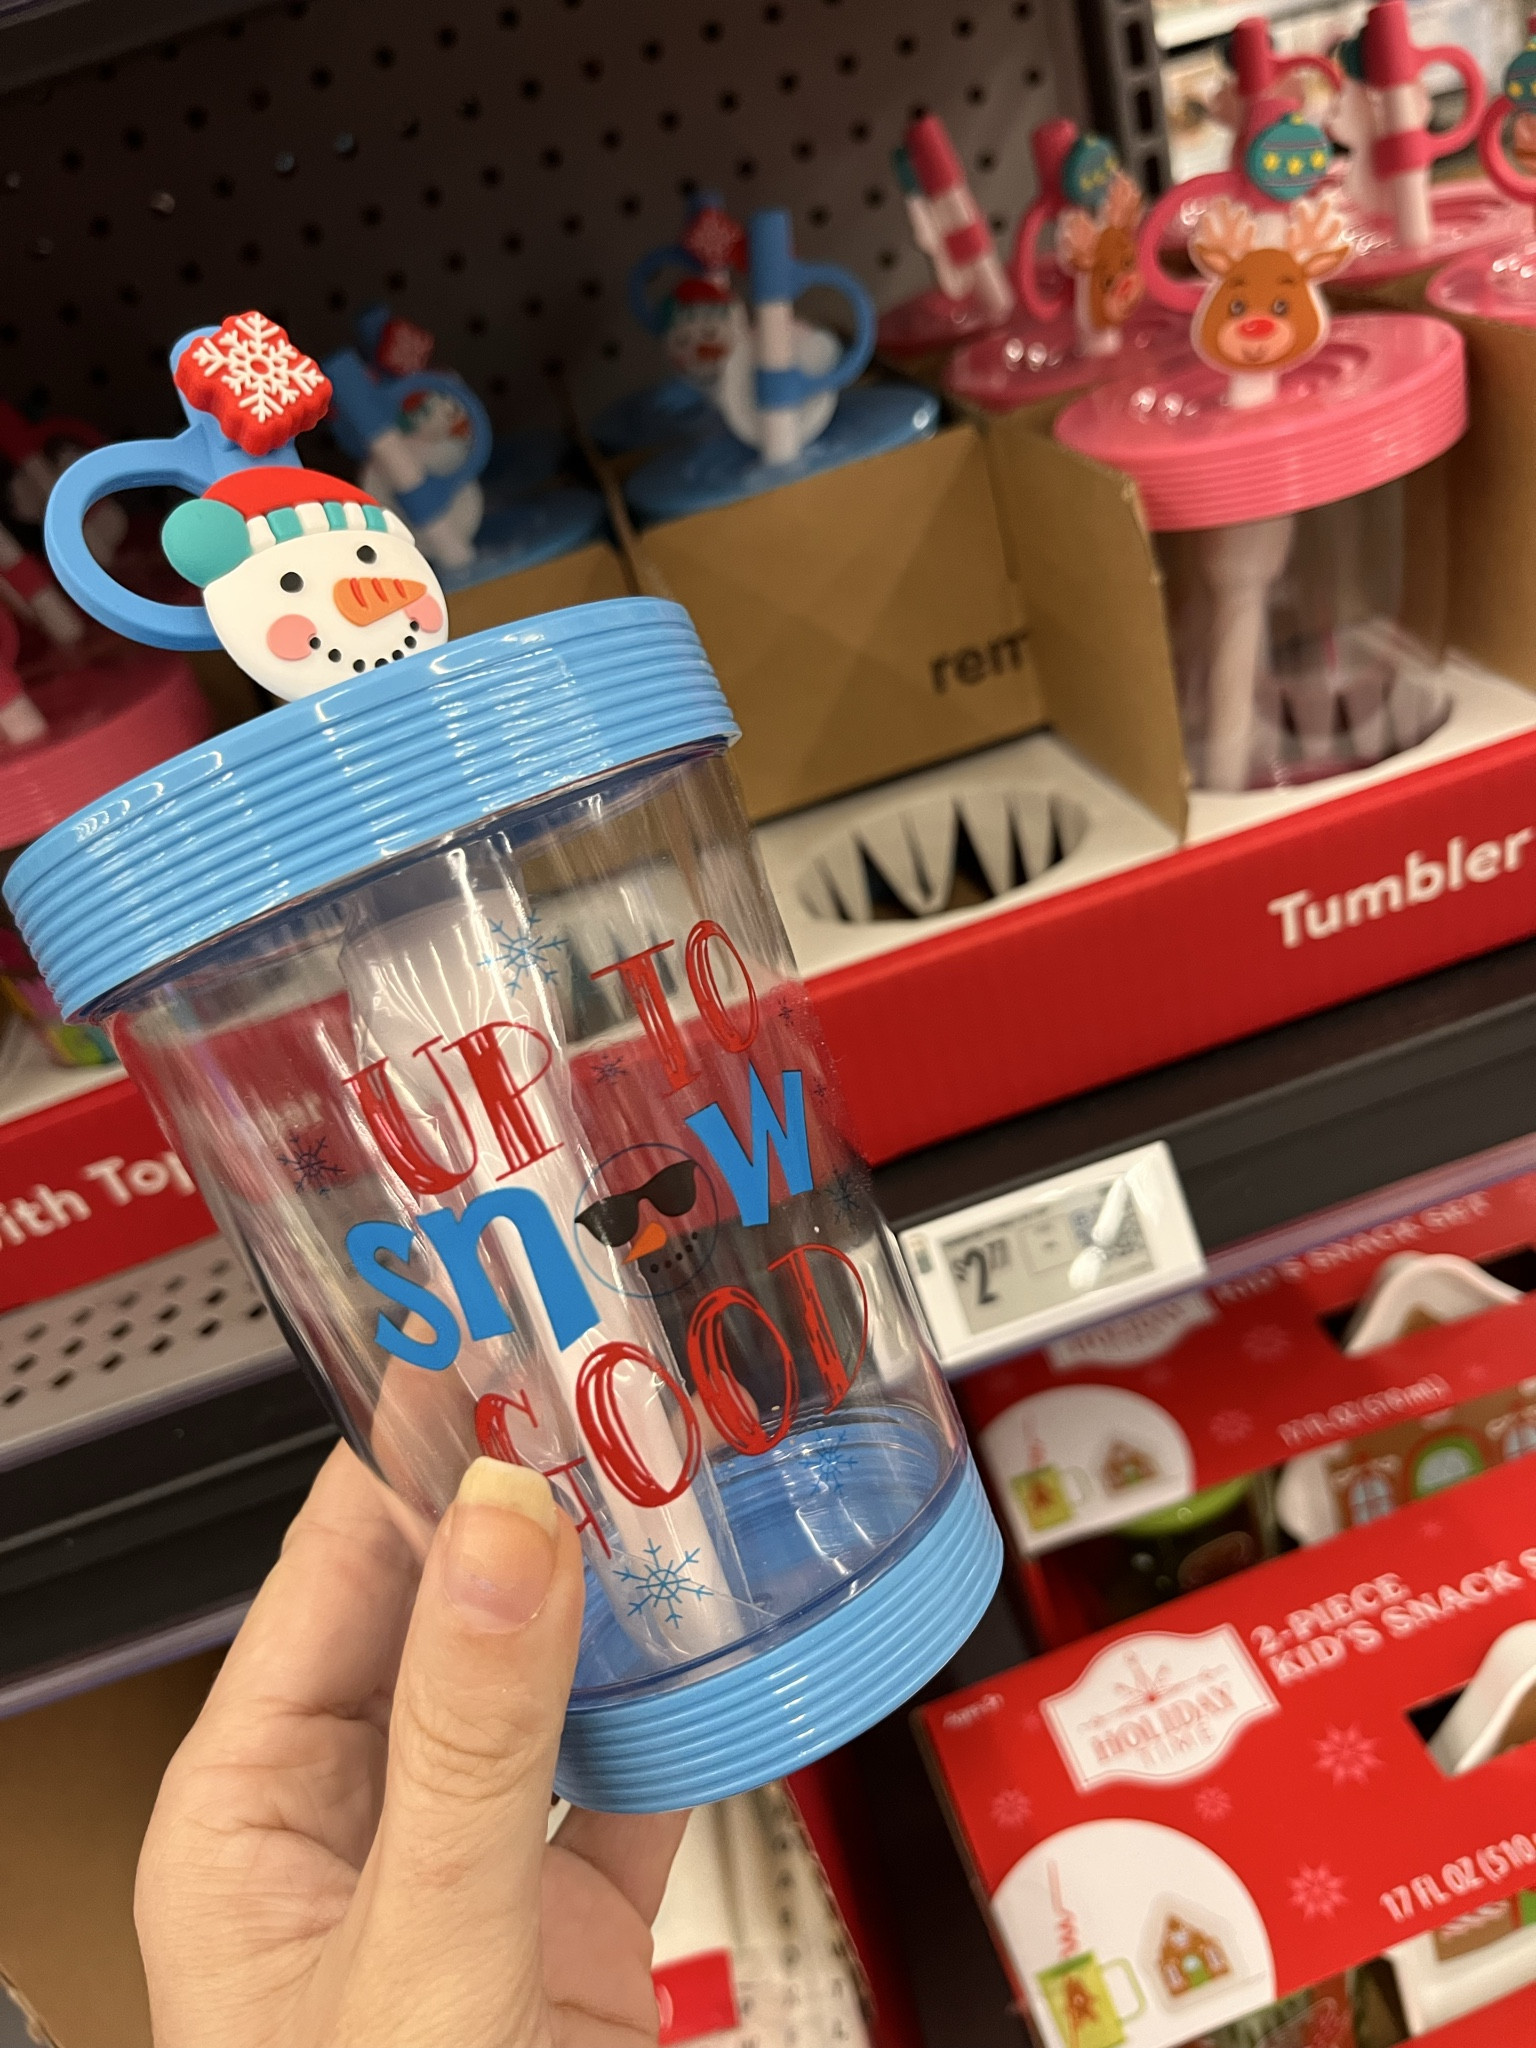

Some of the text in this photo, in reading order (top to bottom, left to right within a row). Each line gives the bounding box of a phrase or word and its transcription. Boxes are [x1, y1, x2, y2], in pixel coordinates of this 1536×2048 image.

[1267, 826, 1536, 949] Tumbler
[342, 919, 759, 1195] UP TO
[0, 1182, 92, 1250] ith
[1250, 1572, 1412, 1658] 2-PIECE
[1267, 1619, 1385, 1687] KID'S
[1380, 1559, 1525, 1639] SNACK
[1379, 1884, 1415, 1922] 17
[1409, 1873, 1452, 1911] FL
[1441, 1855, 1486, 1896] OZ
